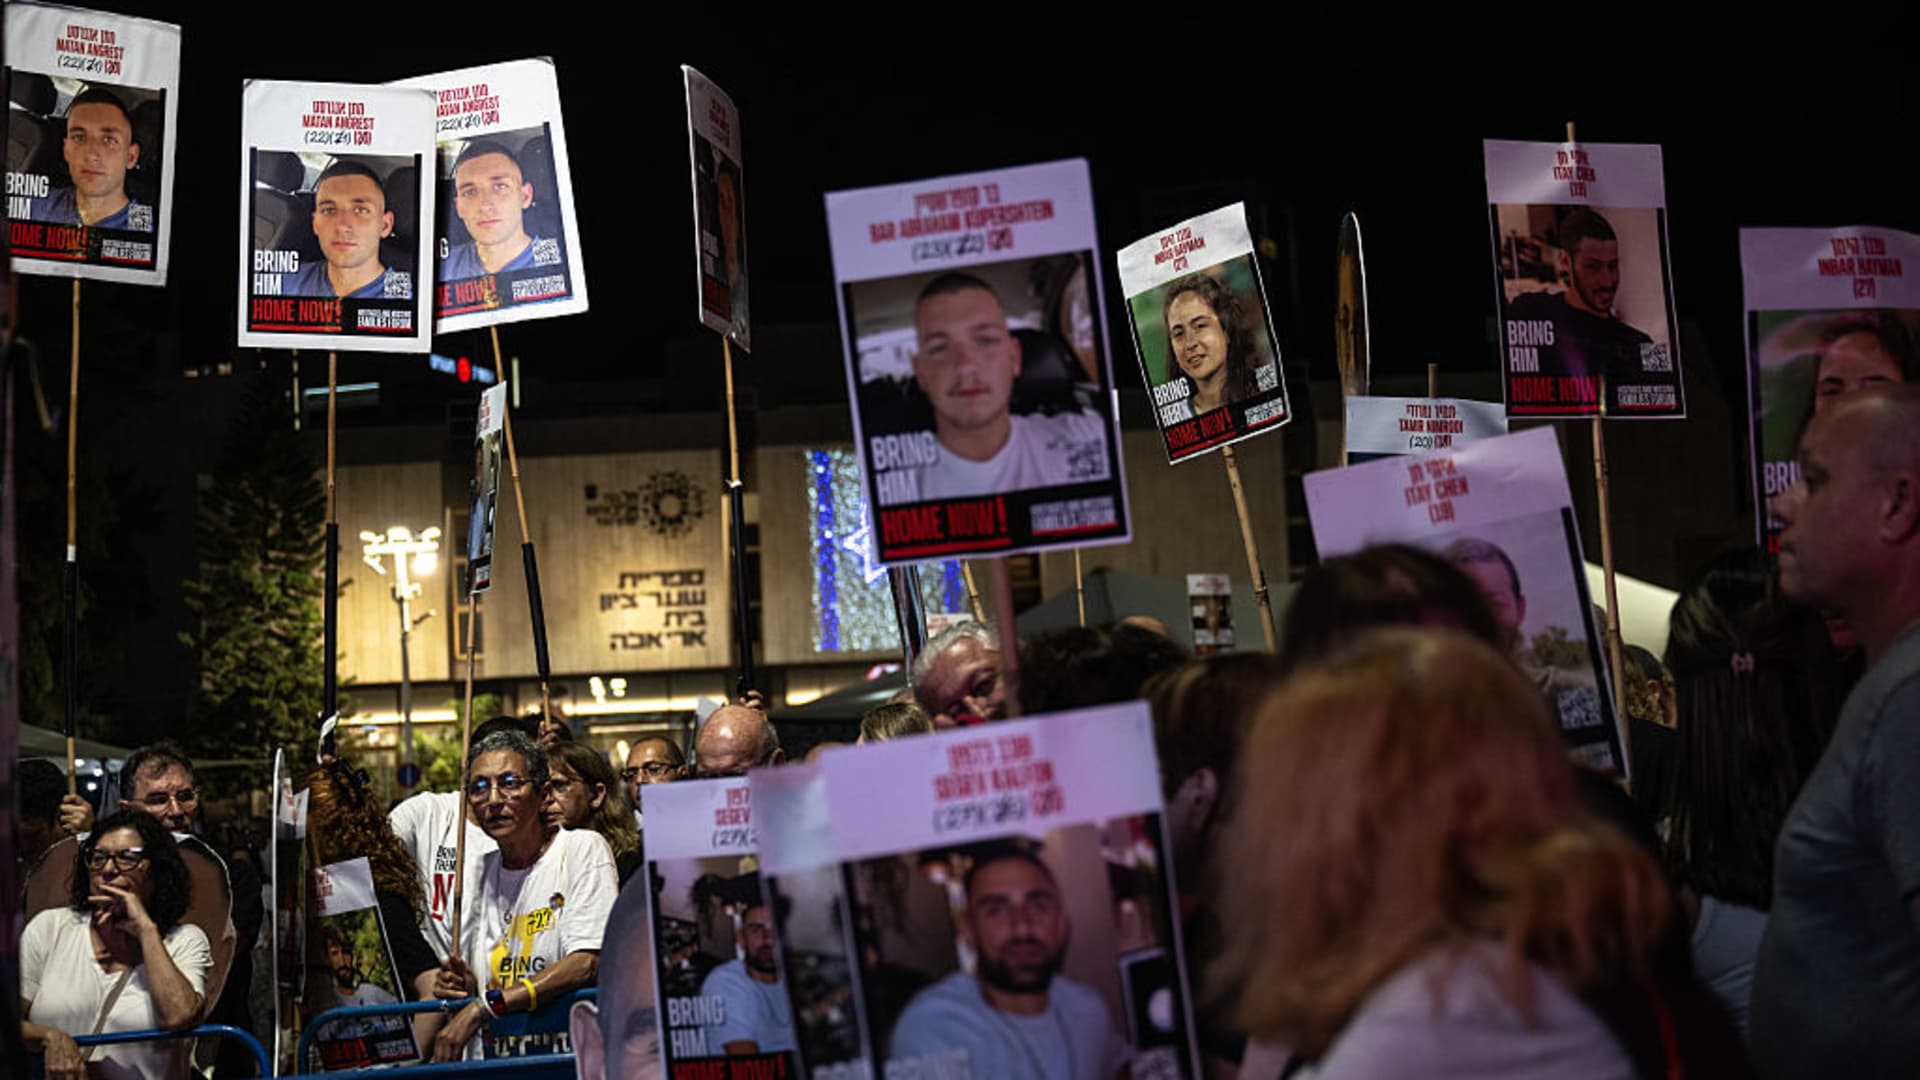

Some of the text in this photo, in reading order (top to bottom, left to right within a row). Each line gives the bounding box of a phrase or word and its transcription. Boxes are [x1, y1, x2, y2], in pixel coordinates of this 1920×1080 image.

[302, 114, 333, 129] MATAN
[5, 172, 50, 198] BRING
[10, 223, 45, 248] OME
[253, 250, 299, 273] BRING
[252, 274, 283, 295] HIM
[252, 298, 342, 324] HOME NOW!
[1506, 320, 1555, 347] BRING
[1510, 348, 1540, 373] HIM
[1152, 377, 1190, 407] BRING
[1510, 376, 1556, 403] HOME
[870, 430, 940, 471] BRING
[875, 471, 919, 507] HIM
[1763, 461, 1800, 495] BRI
[1404, 483, 1431, 507] ITAY
[880, 506, 944, 545] HOME
[945, 494, 1008, 537] NOW!
[715, 807, 751, 827] SEGEV
[667, 995, 725, 1027] BRING
[670, 1027, 708, 1059] HIM
